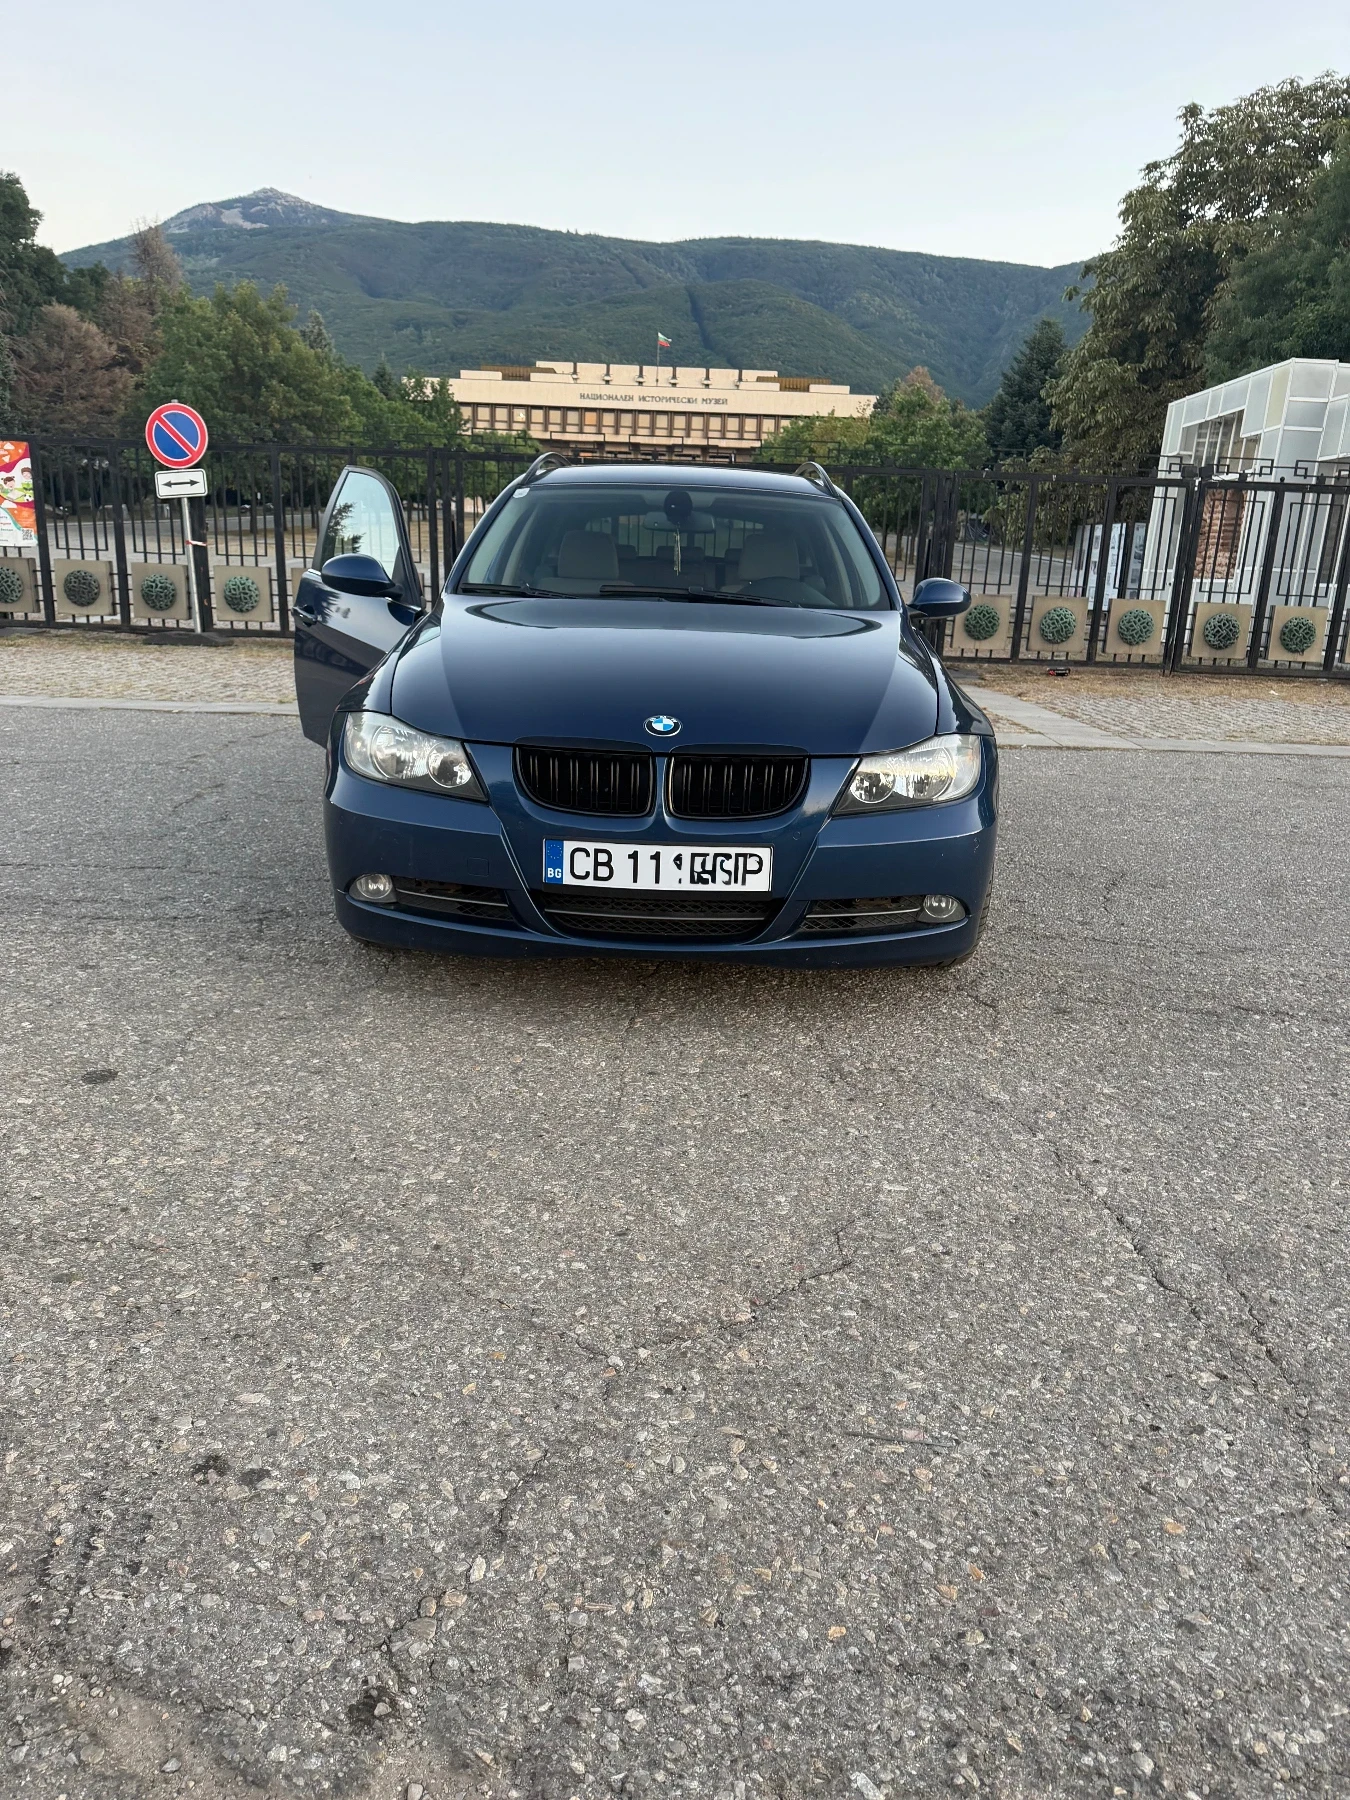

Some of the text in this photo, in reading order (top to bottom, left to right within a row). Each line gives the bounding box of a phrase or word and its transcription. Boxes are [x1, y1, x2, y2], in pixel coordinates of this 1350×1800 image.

[579, 392, 634, 402] НАЦИОНАЛЕН
[638, 394, 698, 405] ИСТОРИЧЕСКИ
[569, 846, 615, 882] CB
[547, 867, 562, 879] BG
